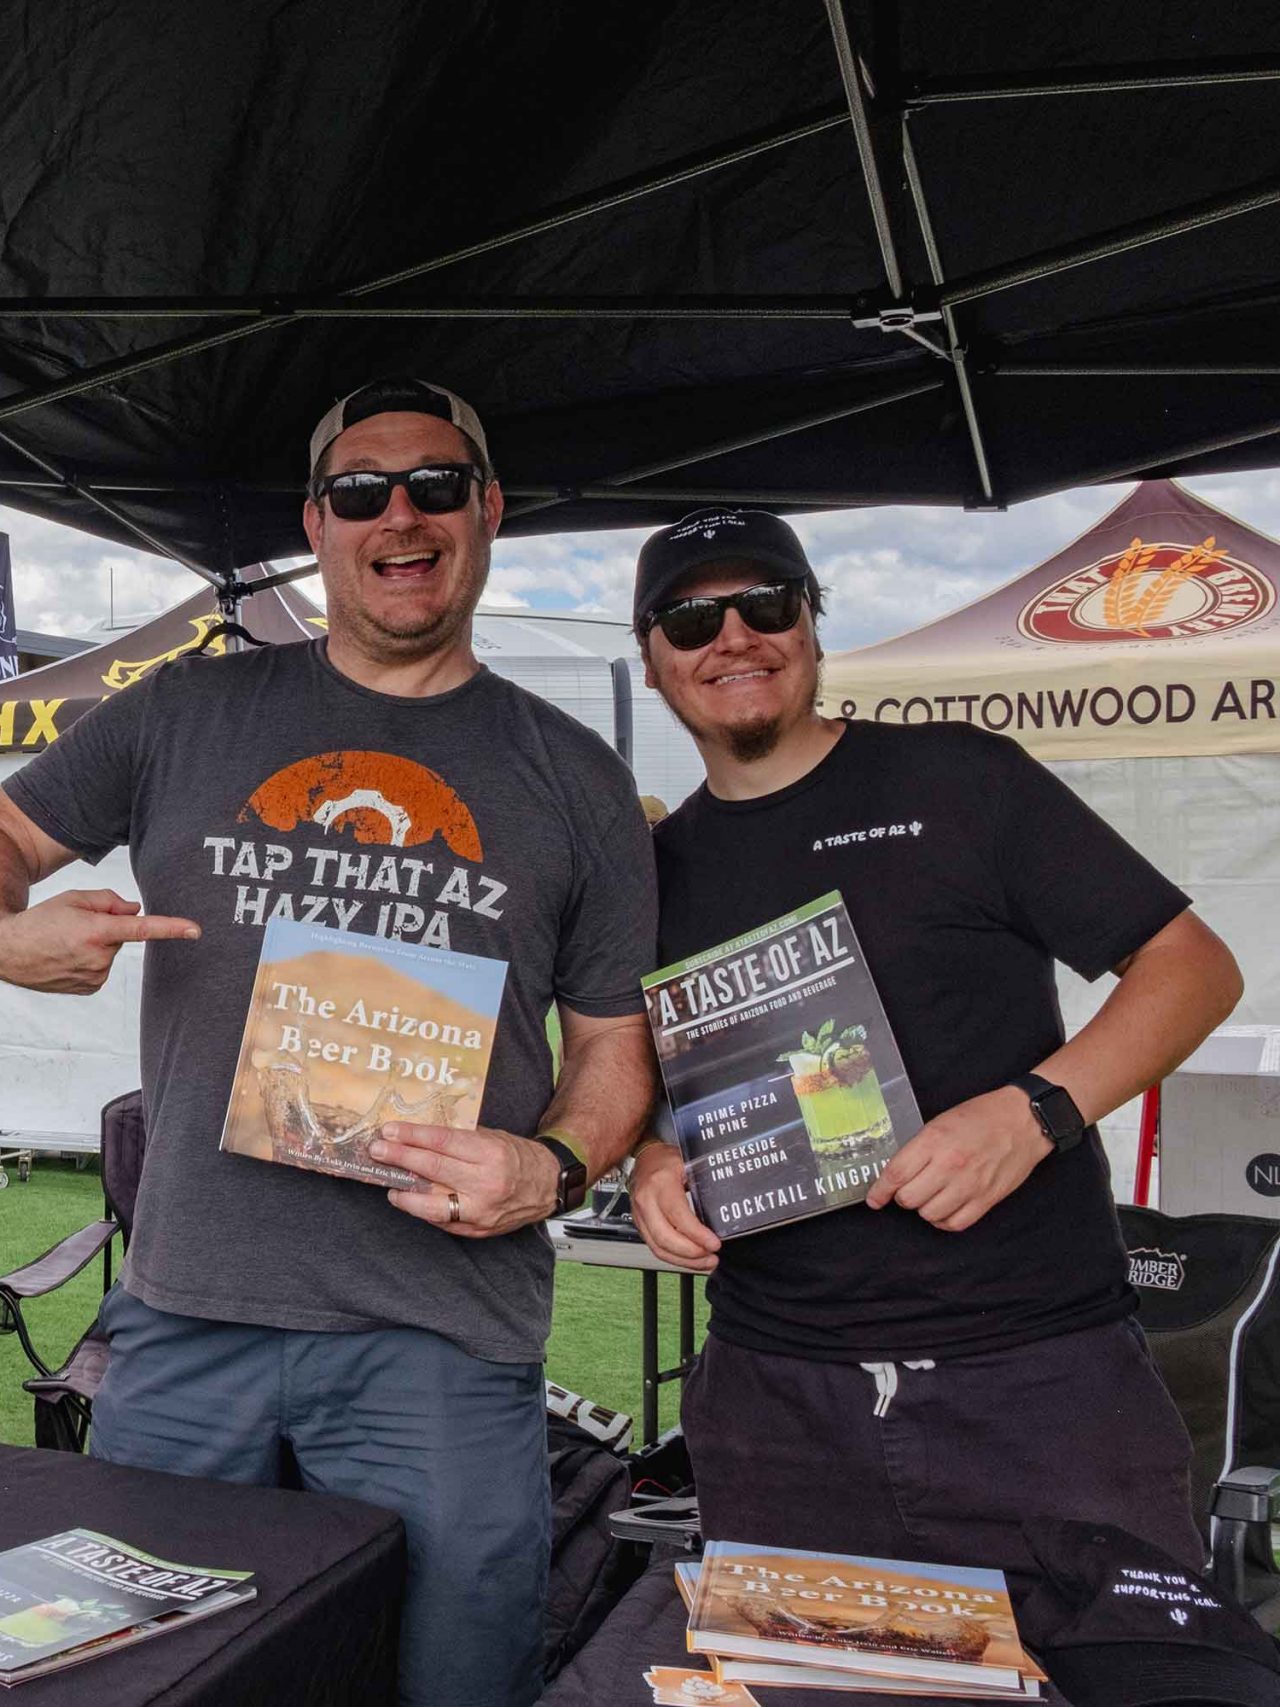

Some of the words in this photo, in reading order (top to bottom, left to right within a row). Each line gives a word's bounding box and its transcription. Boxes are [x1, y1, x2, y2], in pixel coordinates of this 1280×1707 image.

[1169, 568, 1257, 636] BREWERY
[875, 683, 1195, 731] COTTONWOOD
[1211, 679, 1276, 720] AR
[813, 840, 823, 851] A
[825, 831, 866, 847] TASTE
[869, 827, 886, 838] OF
[888, 824, 907, 836] AZ
[203, 837, 293, 881] TAP
[306, 848, 433, 898] THAT
[435, 866, 508, 921] AZ
[233, 885, 366, 932] HAZY
[375, 901, 452, 950] IPA
[659, 989, 679, 1026] A
[680, 953, 767, 1017] TASTE
[769, 935, 801, 982] OF
[809, 916, 849, 966] AZ
[272, 982, 336, 1019] The
[342, 998, 482, 1050] Arizona
[686, 1028, 700, 1040] THE
[701, 1018, 729, 1036] STORIES
[730, 1014, 739, 1025] OF
[740, 1006, 769, 1023] ARIZONA
[769, 998, 788, 1011] FOOD
[788, 990, 803, 1003] AND
[803, 976, 838, 997] BEVERAGE
[278, 1025, 358, 1065] Beer
[367, 1043, 460, 1086] Book
[697, 1104, 737, 1126] PRIME
[741, 1092, 778, 1113] PIZZA
[700, 1129, 715, 1141] IN
[718, 1116, 748, 1136] PINE
[361, 1164, 375, 1173] and
[375, 1167, 389, 1177] Eric
[708, 1136, 778, 1167] CREEKSIDE
[711, 1166, 734, 1182] INN
[738, 1150, 788, 1174] SEDONA
[720, 1184, 808, 1223] COCKTAIL
[814, 1158, 890, 1196] KINGPI
[1128, 1269, 1178, 1288] RIDGE
[43, 1537, 77, 1549] A
[66, 1542, 154, 1579] TASTE
[138, 1571, 190, 1588] OF
[172, 1578, 228, 1597] AZ
[724, 1562, 805, 1583] The
[817, 1575, 996, 1604] Arizona
[1120, 1569, 1162, 1583] THANK
[1163, 1575, 1187, 1585] YOU
[742, 1579, 843, 1602] Beer
[857, 1593, 977, 1617] Book
[1113, 1584, 1191, 1602] SUPPORTING
